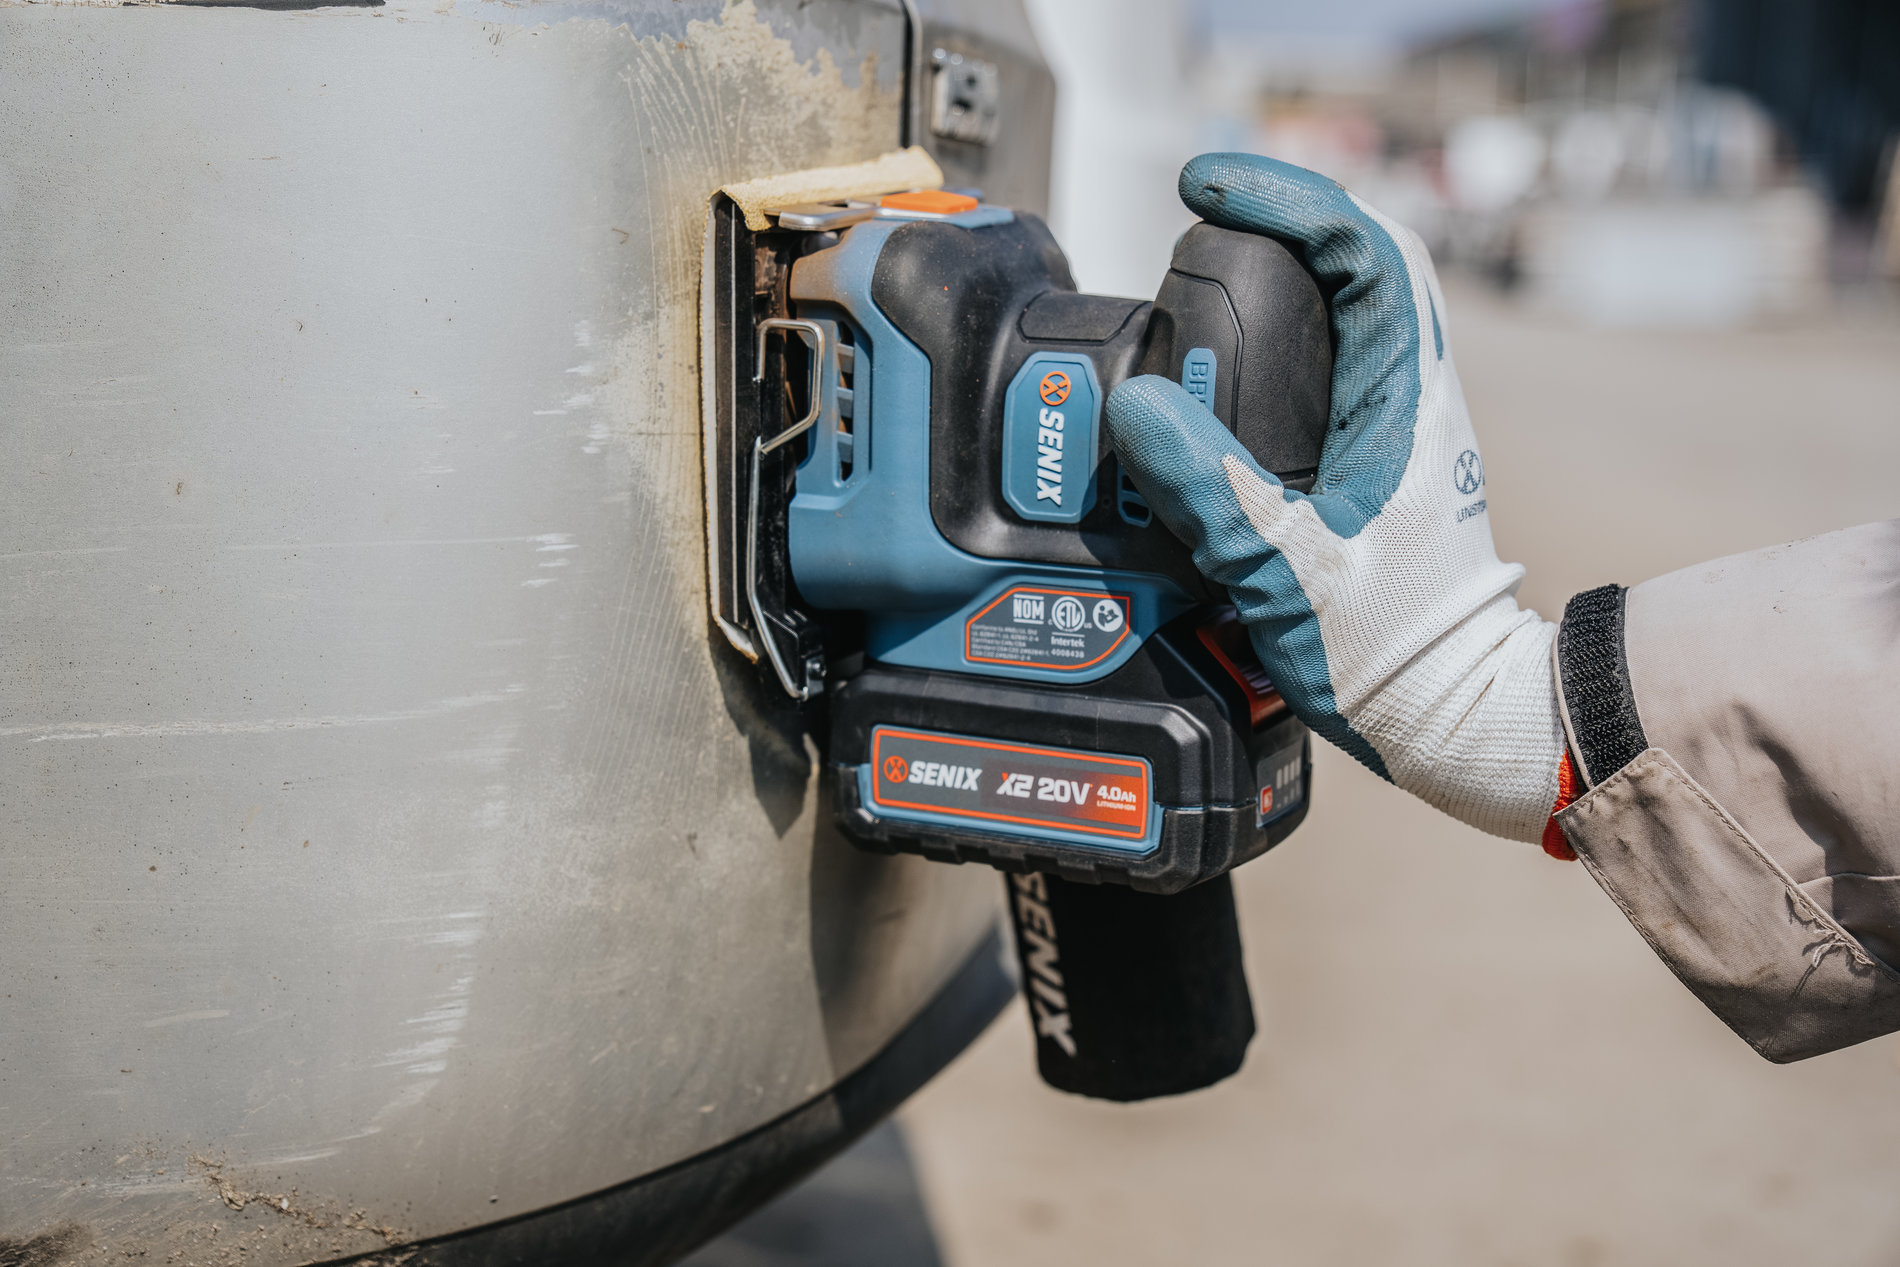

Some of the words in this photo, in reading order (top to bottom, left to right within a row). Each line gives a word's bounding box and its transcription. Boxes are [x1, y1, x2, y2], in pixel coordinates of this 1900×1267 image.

[1187, 362, 1210, 403] BR
[1036, 407, 1065, 506] SENIX
[1013, 598, 1044, 620] NOM
[1050, 635, 1085, 648] Intertek
[908, 760, 983, 791] SENIX
[996, 772, 1035, 799] X2
[1037, 777, 1091, 805] 20V
[1096, 785, 1137, 803] 4.0Ah
